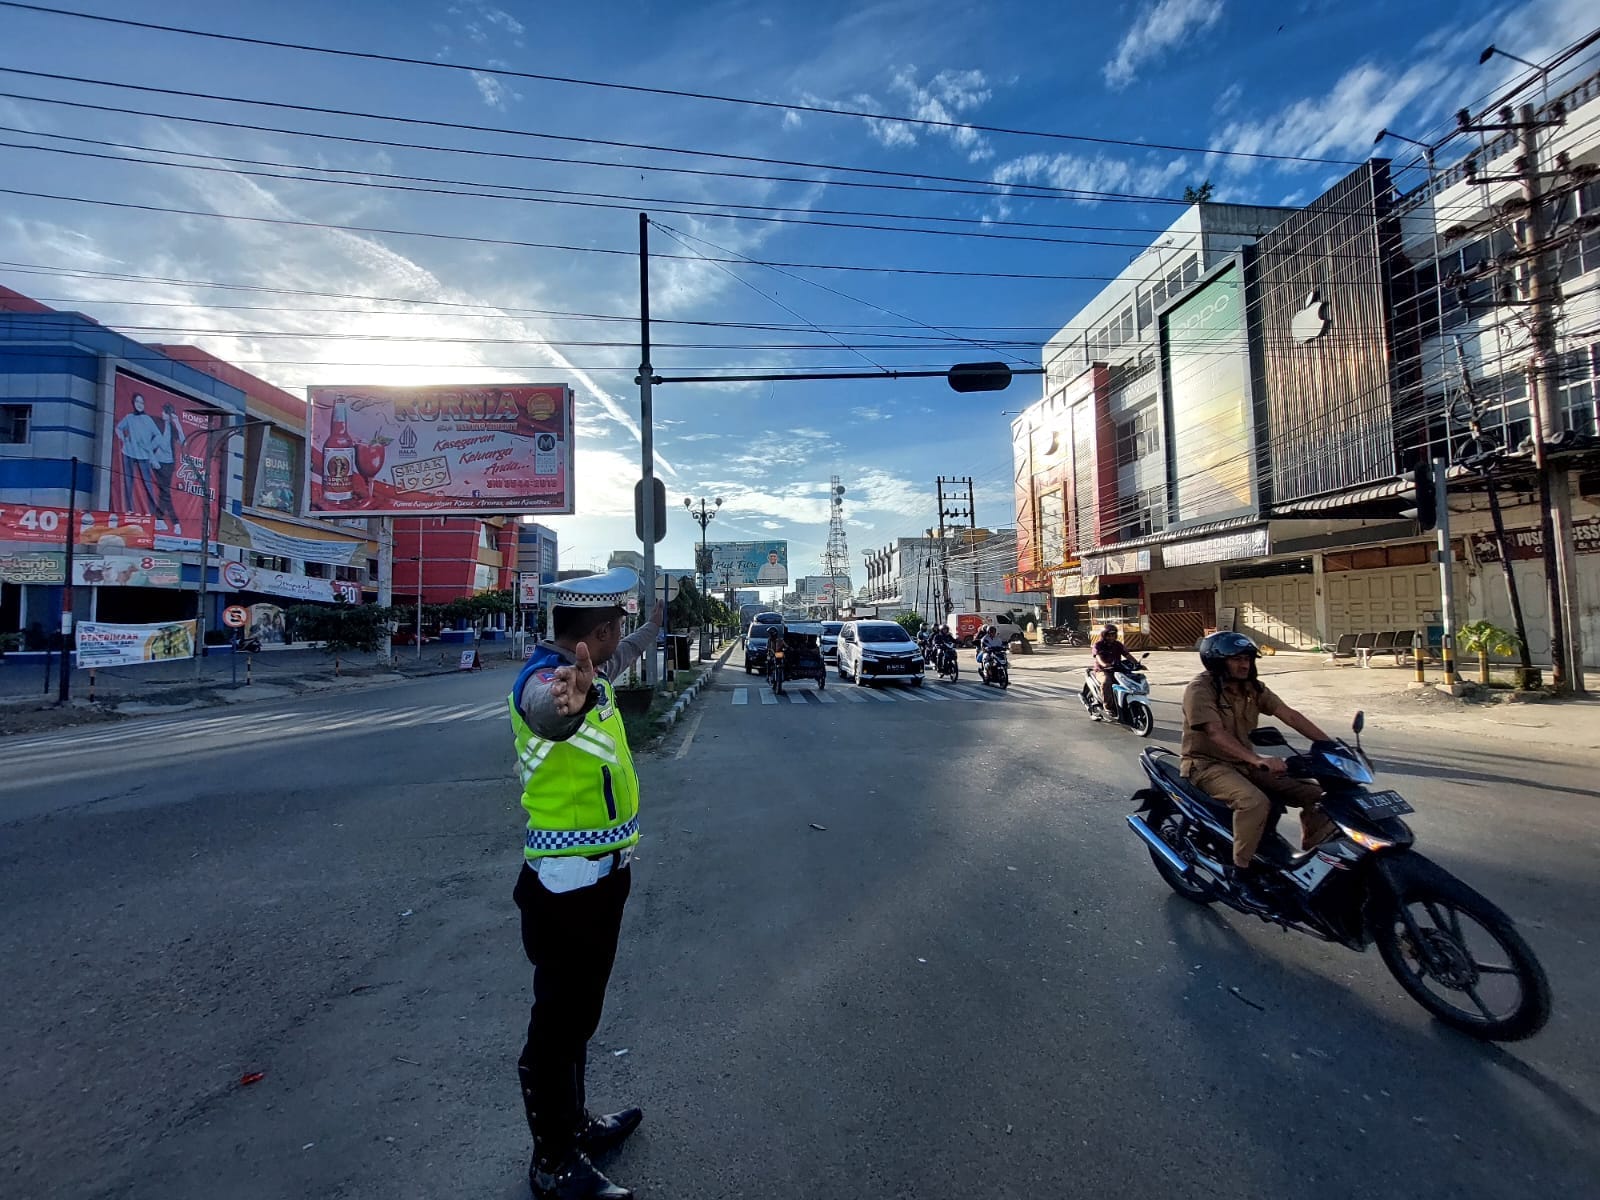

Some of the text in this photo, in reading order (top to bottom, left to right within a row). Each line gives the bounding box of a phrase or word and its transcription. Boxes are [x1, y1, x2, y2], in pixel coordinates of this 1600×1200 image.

[433, 434, 495, 452] Kesegaran
[459, 447, 513, 465] Keluarga
[395, 458, 444, 478] SEJAK
[398, 472, 447, 491] 1969
[19, 509, 59, 532] 40
